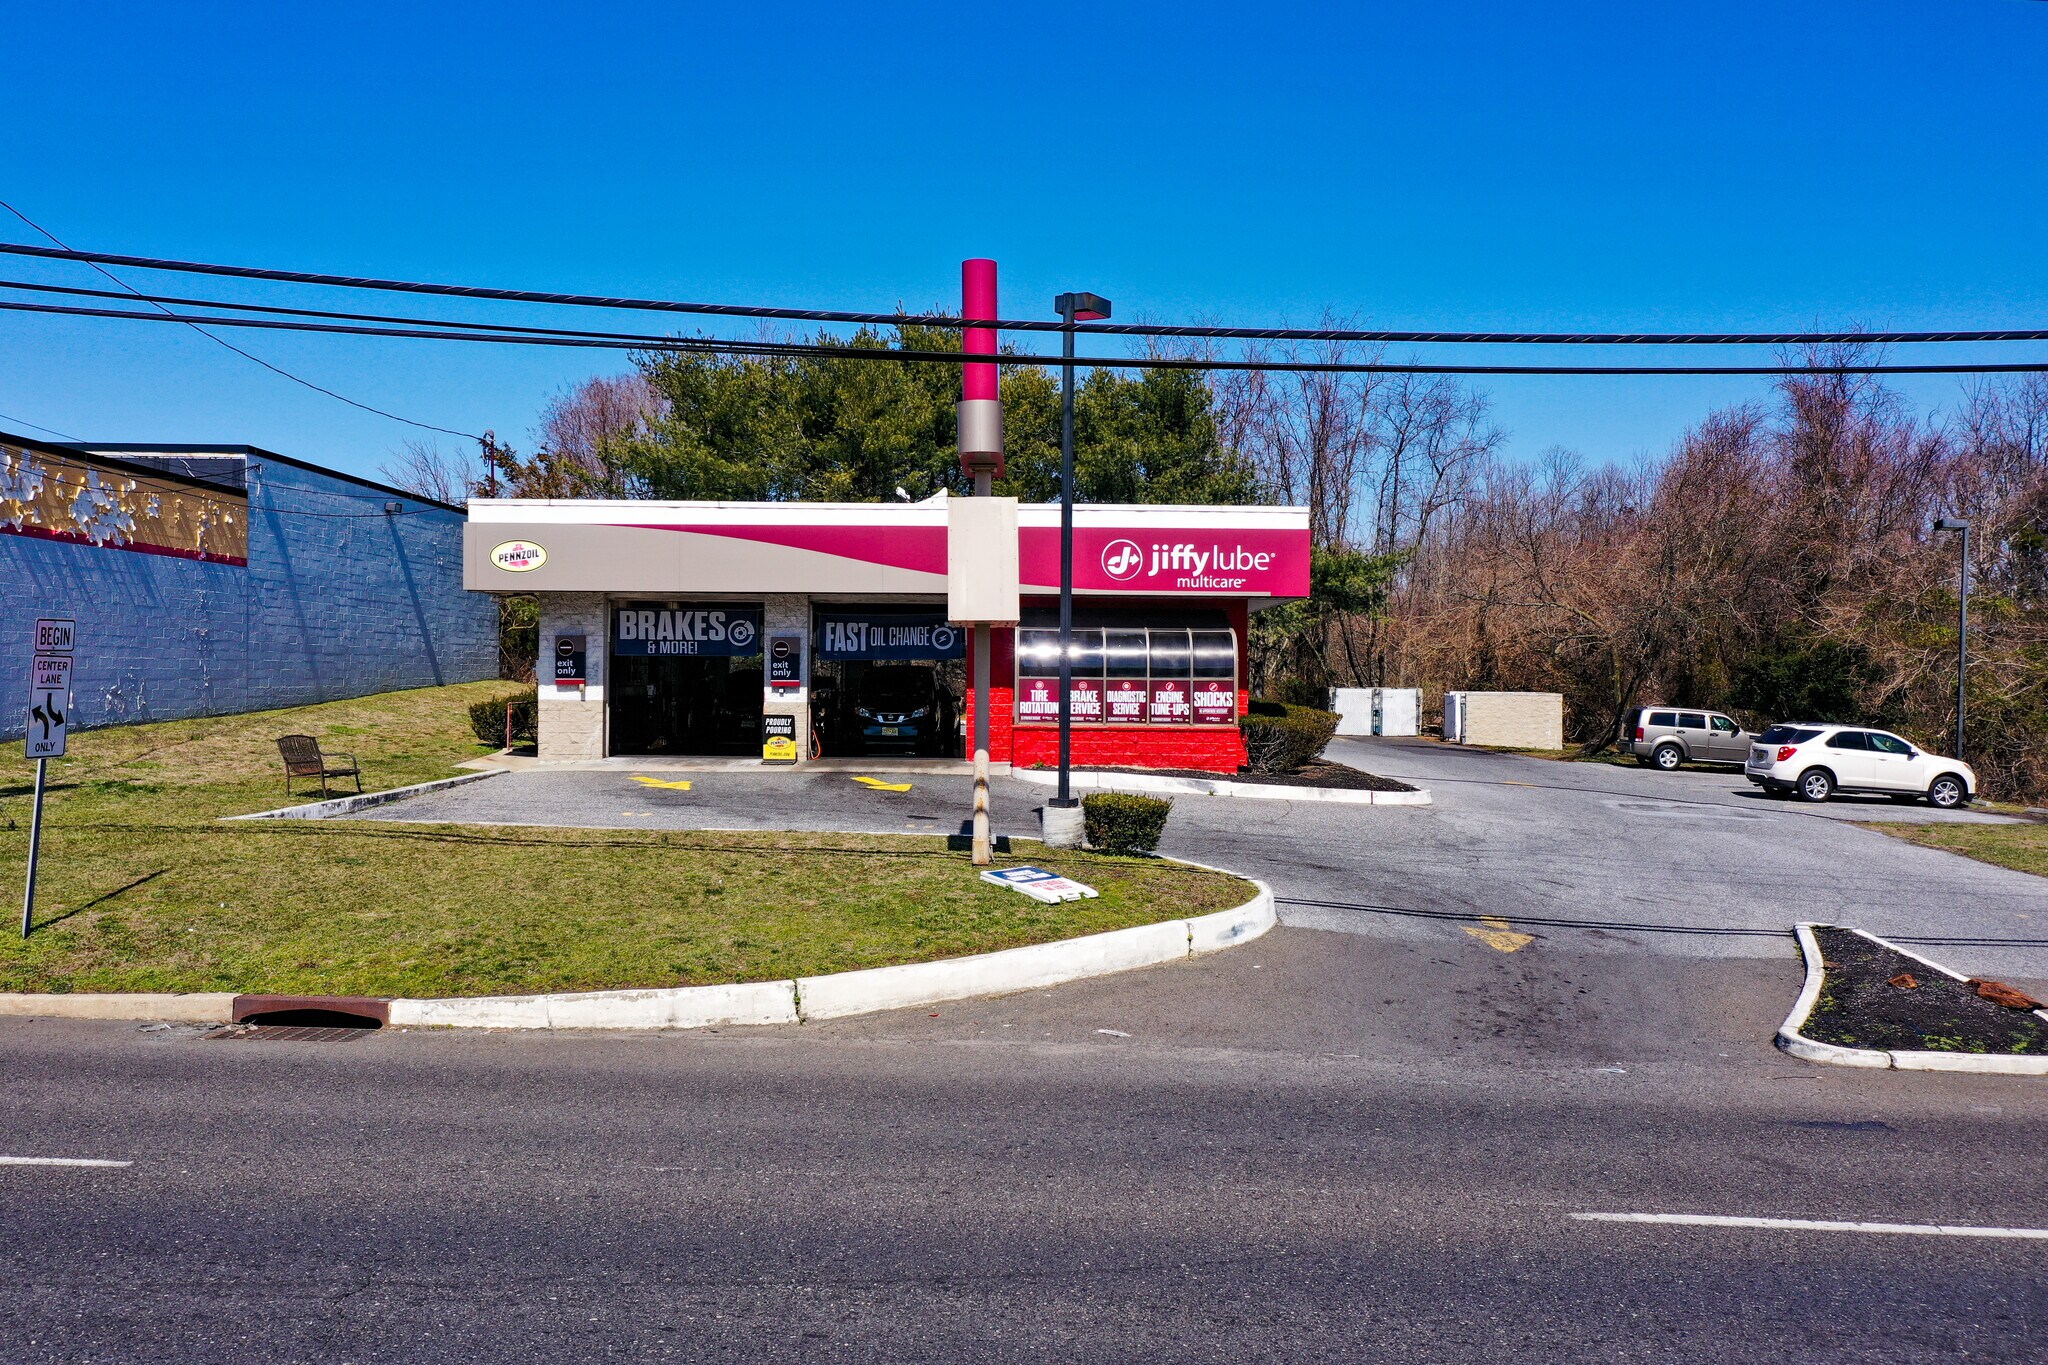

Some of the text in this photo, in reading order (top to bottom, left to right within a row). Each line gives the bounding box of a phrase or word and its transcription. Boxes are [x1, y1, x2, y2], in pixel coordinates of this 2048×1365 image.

[498, 549, 540, 563] PENNZOIL
[1148, 544, 1270, 577] jiffy lube
[1177, 575, 1242, 588] multicare
[619, 610, 726, 641] BRAKES
[40, 627, 71, 646] BEGIN
[825, 622, 930, 652] FAST OIL CHANGE
[647, 641, 698, 654] & MORE!
[37, 660, 68, 672] CENTER
[557, 659, 573, 667] exit
[772, 660, 789, 669] exit
[557, 667, 576, 676] only
[772, 669, 791, 678] only
[40, 674, 62, 684] LANE
[1030, 689, 1049, 702] TIRE
[1106, 690, 1146, 703] DIAGNOSTIC
[1155, 691, 1185, 703] ENGINE
[1193, 691, 1234, 708] SHOCKS
[1019, 701, 1060, 714] ROTATION
[1070, 702, 1102, 715] ERVICE
[1112, 703, 1140, 715] SERVICE
[1150, 703, 1190, 716] TUNE-UPS
[765, 718, 792, 726] PROUDLY
[765, 726, 792, 734] POURING
[34, 742, 56, 753] ONLY
